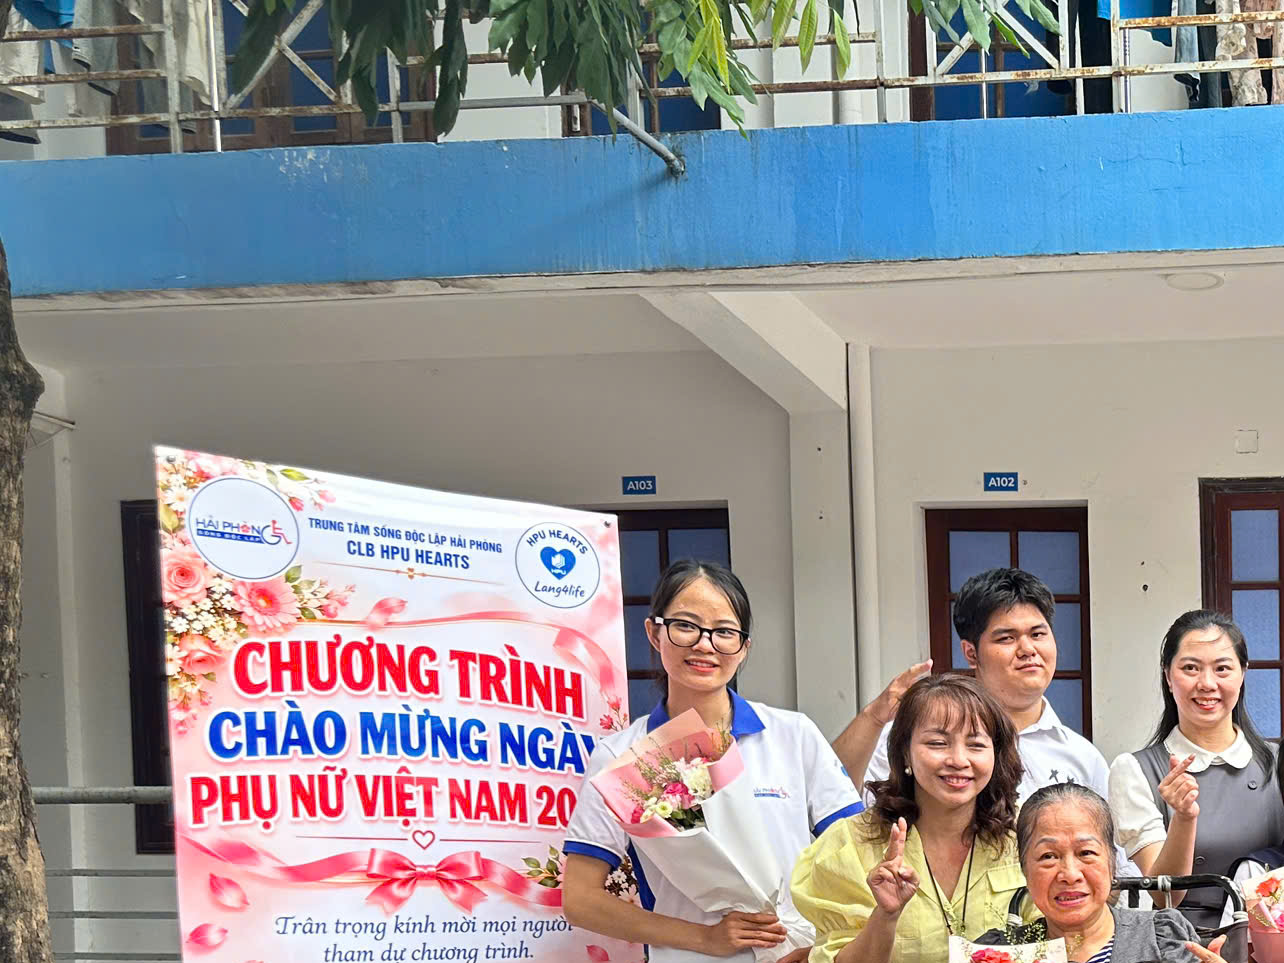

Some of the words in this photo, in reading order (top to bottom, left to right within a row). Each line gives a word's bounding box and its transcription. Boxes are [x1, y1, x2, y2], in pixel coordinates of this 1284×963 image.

[627, 480, 653, 490] A103
[988, 477, 1015, 487] A102
[308, 517, 344, 532] TRUNG
[347, 521, 370, 535] TÂM
[405, 529, 425, 545] ĐỘC
[428, 532, 447, 548] LẬP
[450, 534, 467, 549] HẢI
[526, 530, 546, 547] HPU
[549, 529, 588, 554] HEARTS
[347, 540, 375, 557] CLB
[380, 544, 410, 562] HPU
[415, 548, 470, 570] HEARTS
[534, 581, 585, 598] Lang4life
[233, 634, 437, 696] CHƯƠNG
[449, 643, 584, 719] TRÌNH
[208, 700, 346, 757] CHÀO
[360, 704, 488, 763] MỪNG
[189, 776, 276, 831] PHỤ
[291, 766, 348, 819] NỮ
[353, 767, 439, 828] VIỆT
[448, 778, 528, 824] NAM
[275, 915, 327, 936] Trân
[334, 918, 387, 941] trọng
[393, 915, 436, 935] kính
[442, 916, 477, 934] mời
[483, 917, 517, 936] mọi
[324, 943, 374, 963] tham
[485, 940, 534, 960] trình.
